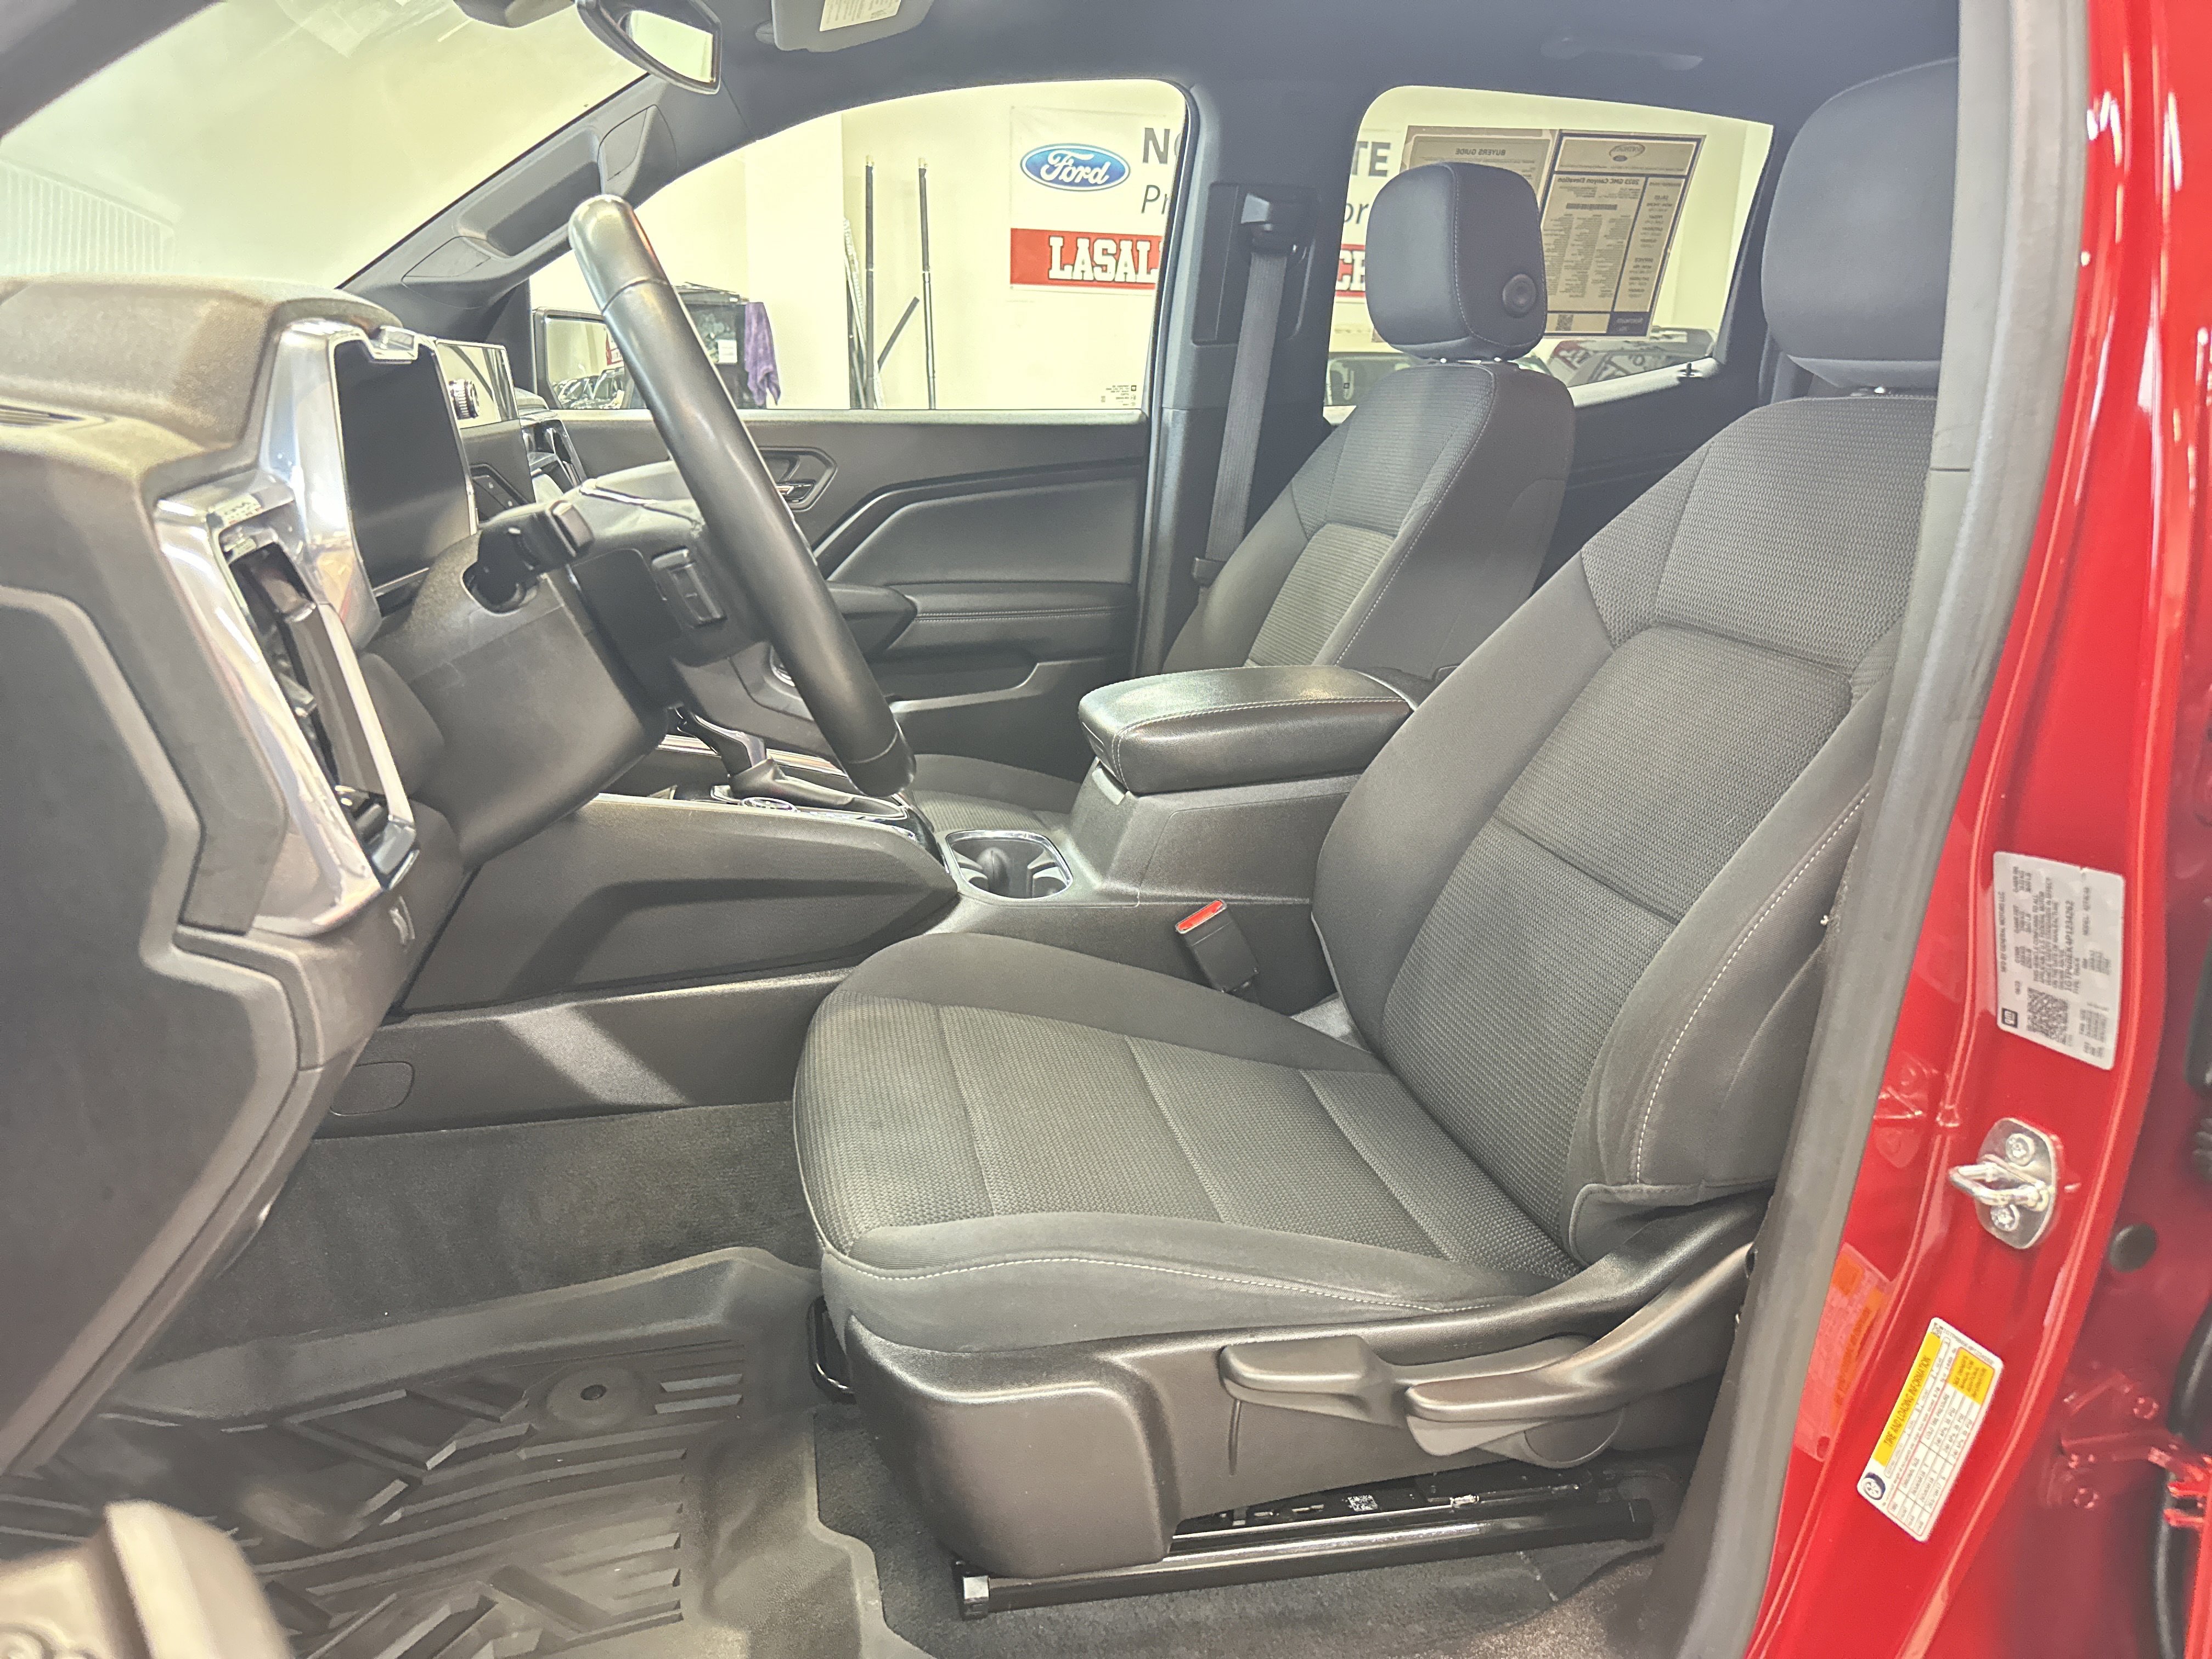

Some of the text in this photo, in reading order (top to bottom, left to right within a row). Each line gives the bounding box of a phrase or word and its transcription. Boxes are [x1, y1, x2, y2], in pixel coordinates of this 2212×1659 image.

[1143, 127, 1182, 165] N
[1048, 235, 1162, 285] LASAL
[1906, 1353, 1931, 1396] INFORMATION
[1895, 1392, 1914, 1423] LOADING
[1883, 1430, 1897, 1448] TIRE
[1889, 1417, 1903, 1435] AND
